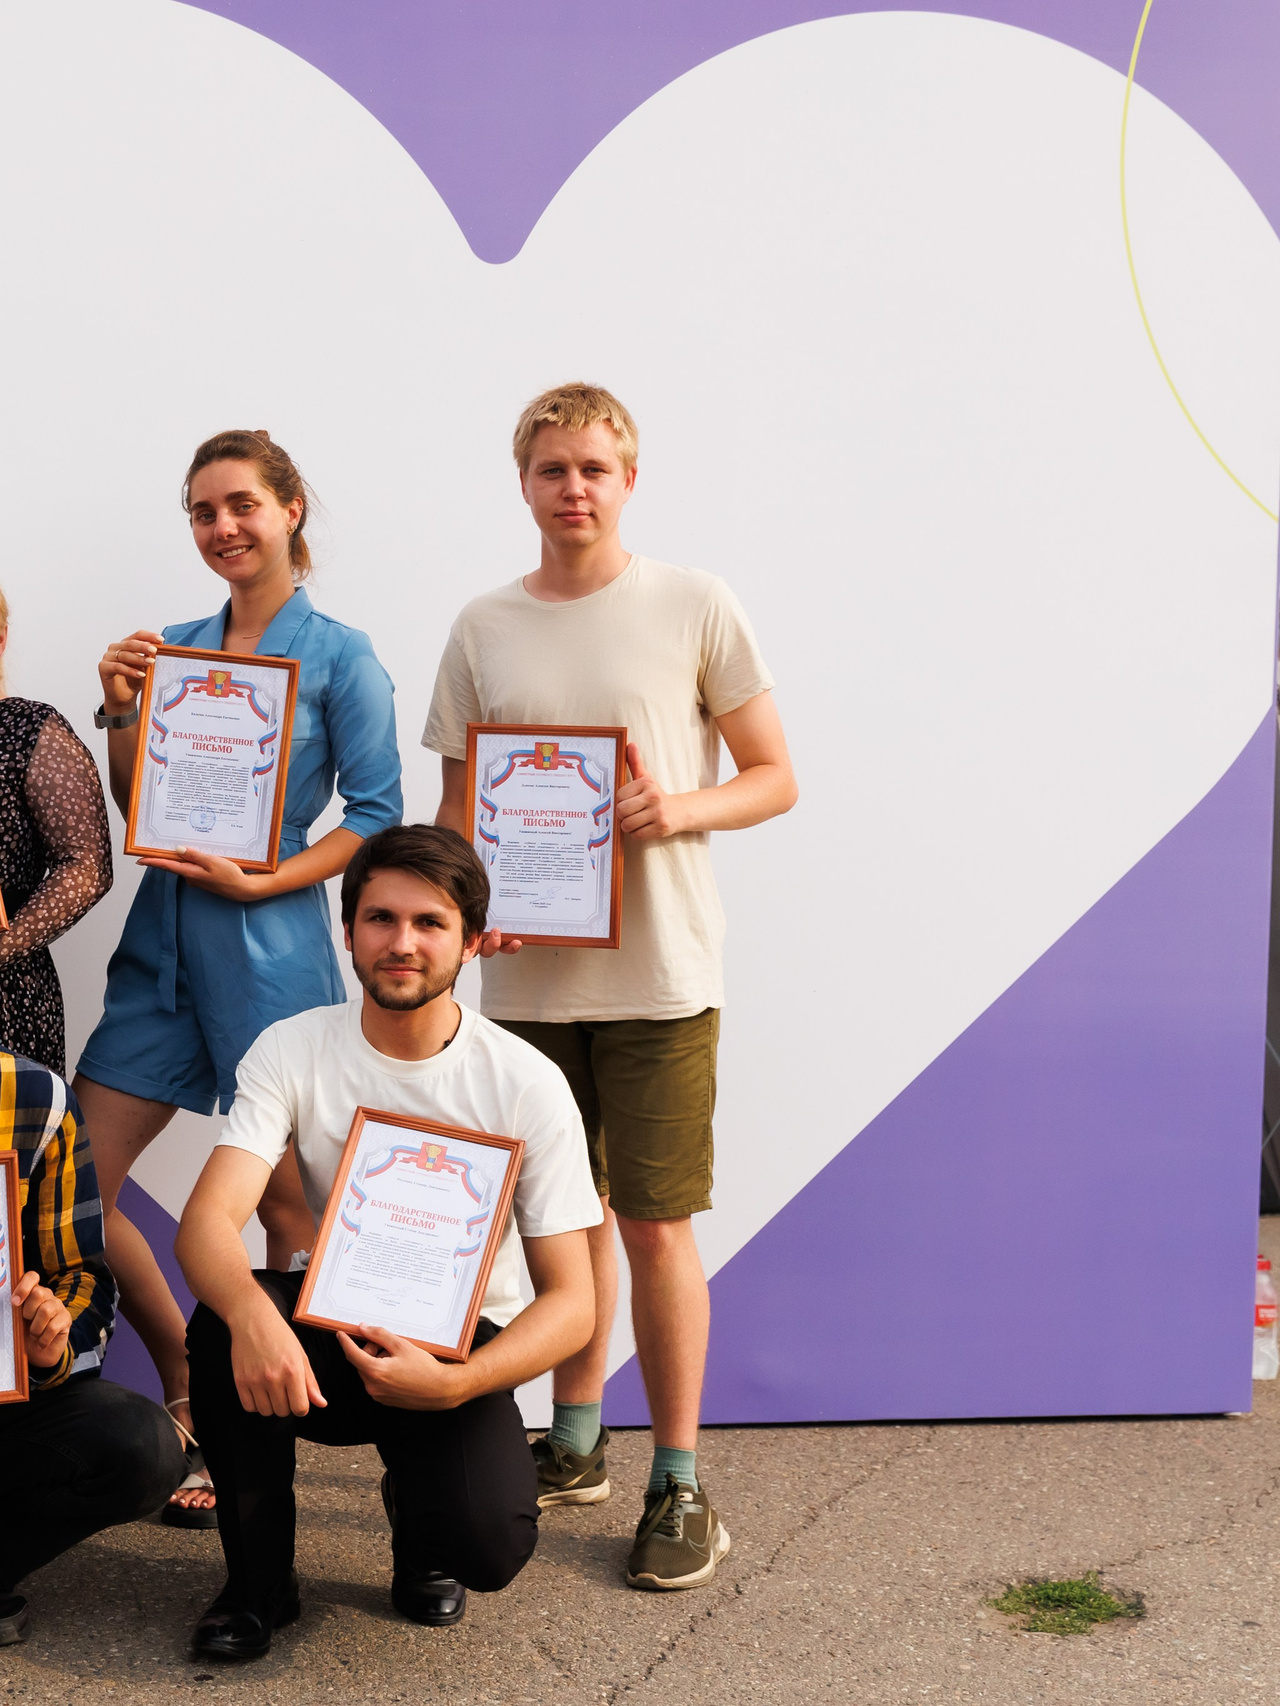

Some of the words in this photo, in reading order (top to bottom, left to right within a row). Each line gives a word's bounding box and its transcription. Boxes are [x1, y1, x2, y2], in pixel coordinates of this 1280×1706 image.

[172, 731, 254, 747] БЛАГОДАРСТВЕННОЕ
[192, 742, 233, 754] ПИСЬМО
[502, 808, 588, 819] БЛАГОДАРСТВЕННОЕ
[523, 818, 566, 828] ПИСЬМО
[370, 1199, 462, 1226] БЛАГОДАРСТВЕННОЕ
[390, 1212, 436, 1230] ПИСЬМО
